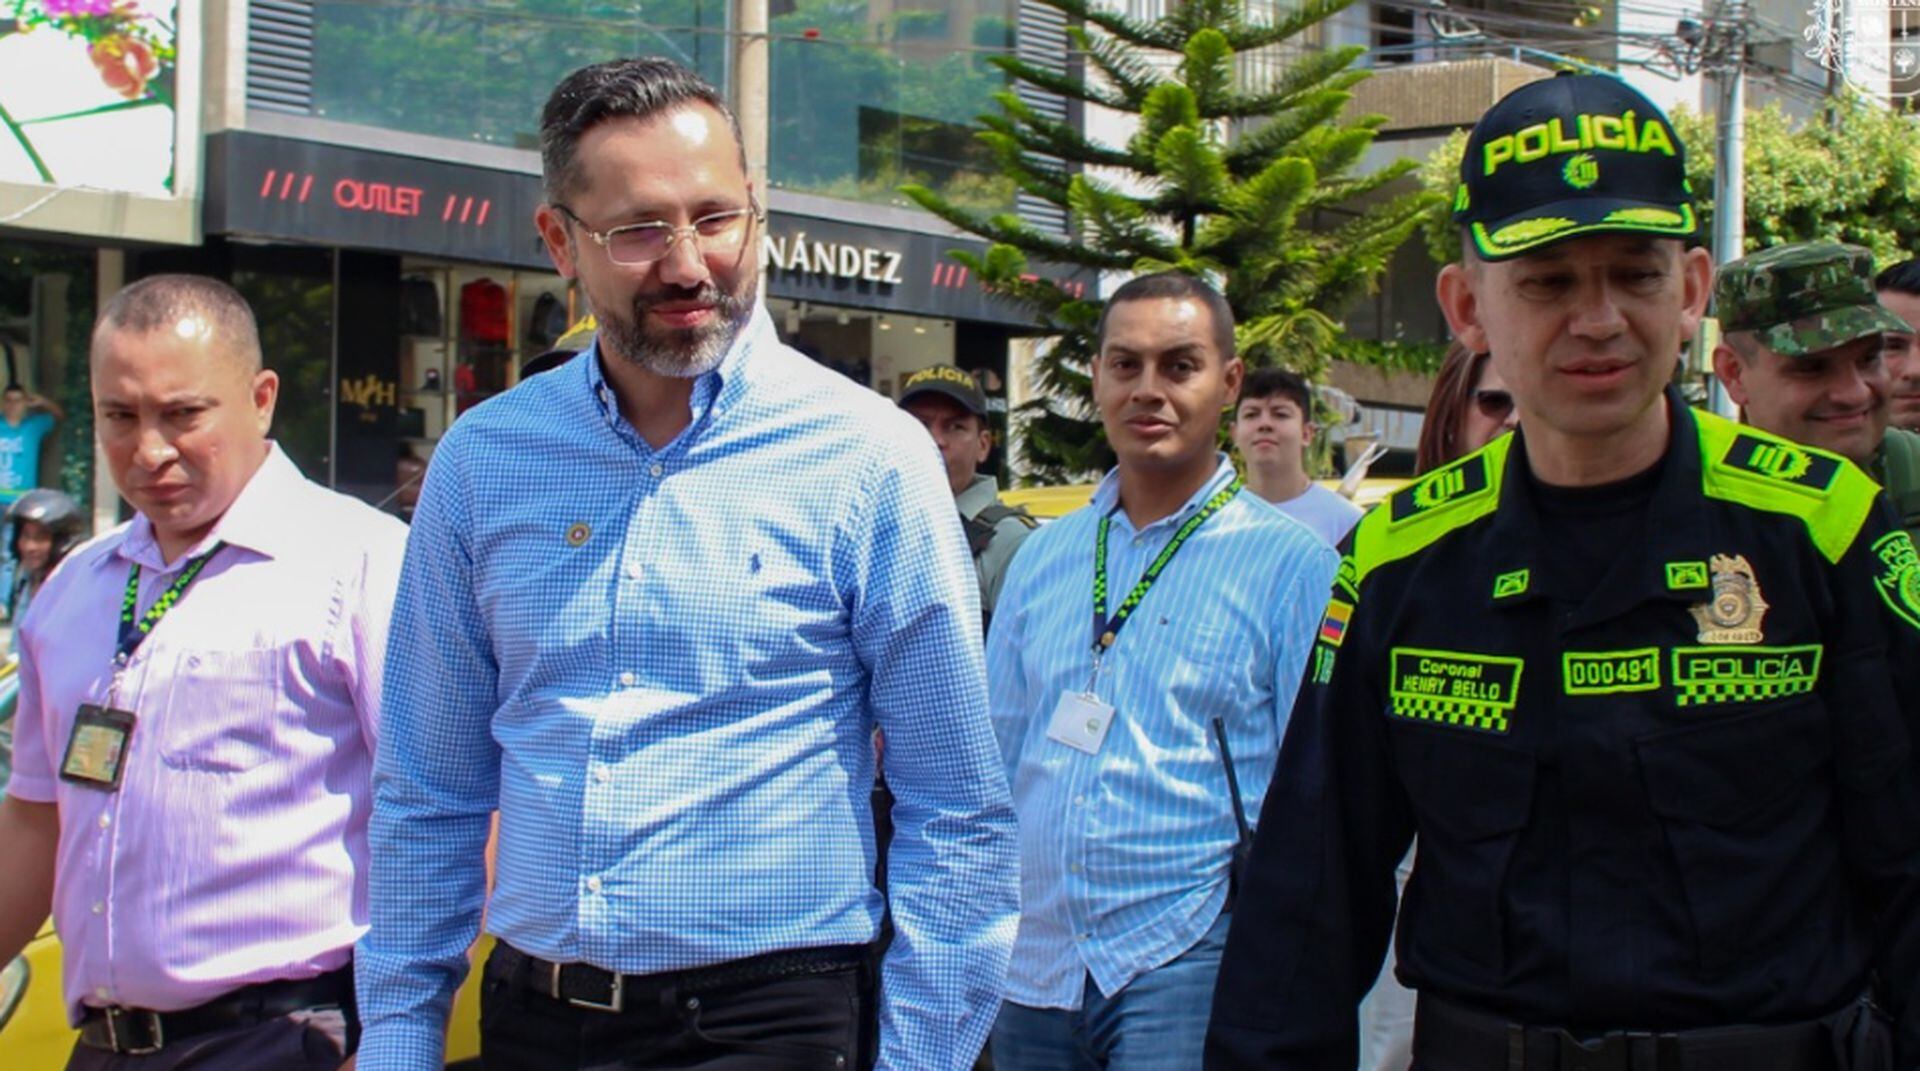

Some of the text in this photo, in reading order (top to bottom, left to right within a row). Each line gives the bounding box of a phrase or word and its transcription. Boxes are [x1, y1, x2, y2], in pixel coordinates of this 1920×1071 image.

[1484, 109, 1676, 177] POLICÍA
[333, 178, 423, 216] OUTLET
[763, 231, 903, 284] NÁNDEZ
[1572, 658, 1652, 685] 000491
[1689, 654, 1804, 679] POLICÍA
[1403, 674, 1500, 700] HENRY BELLO
